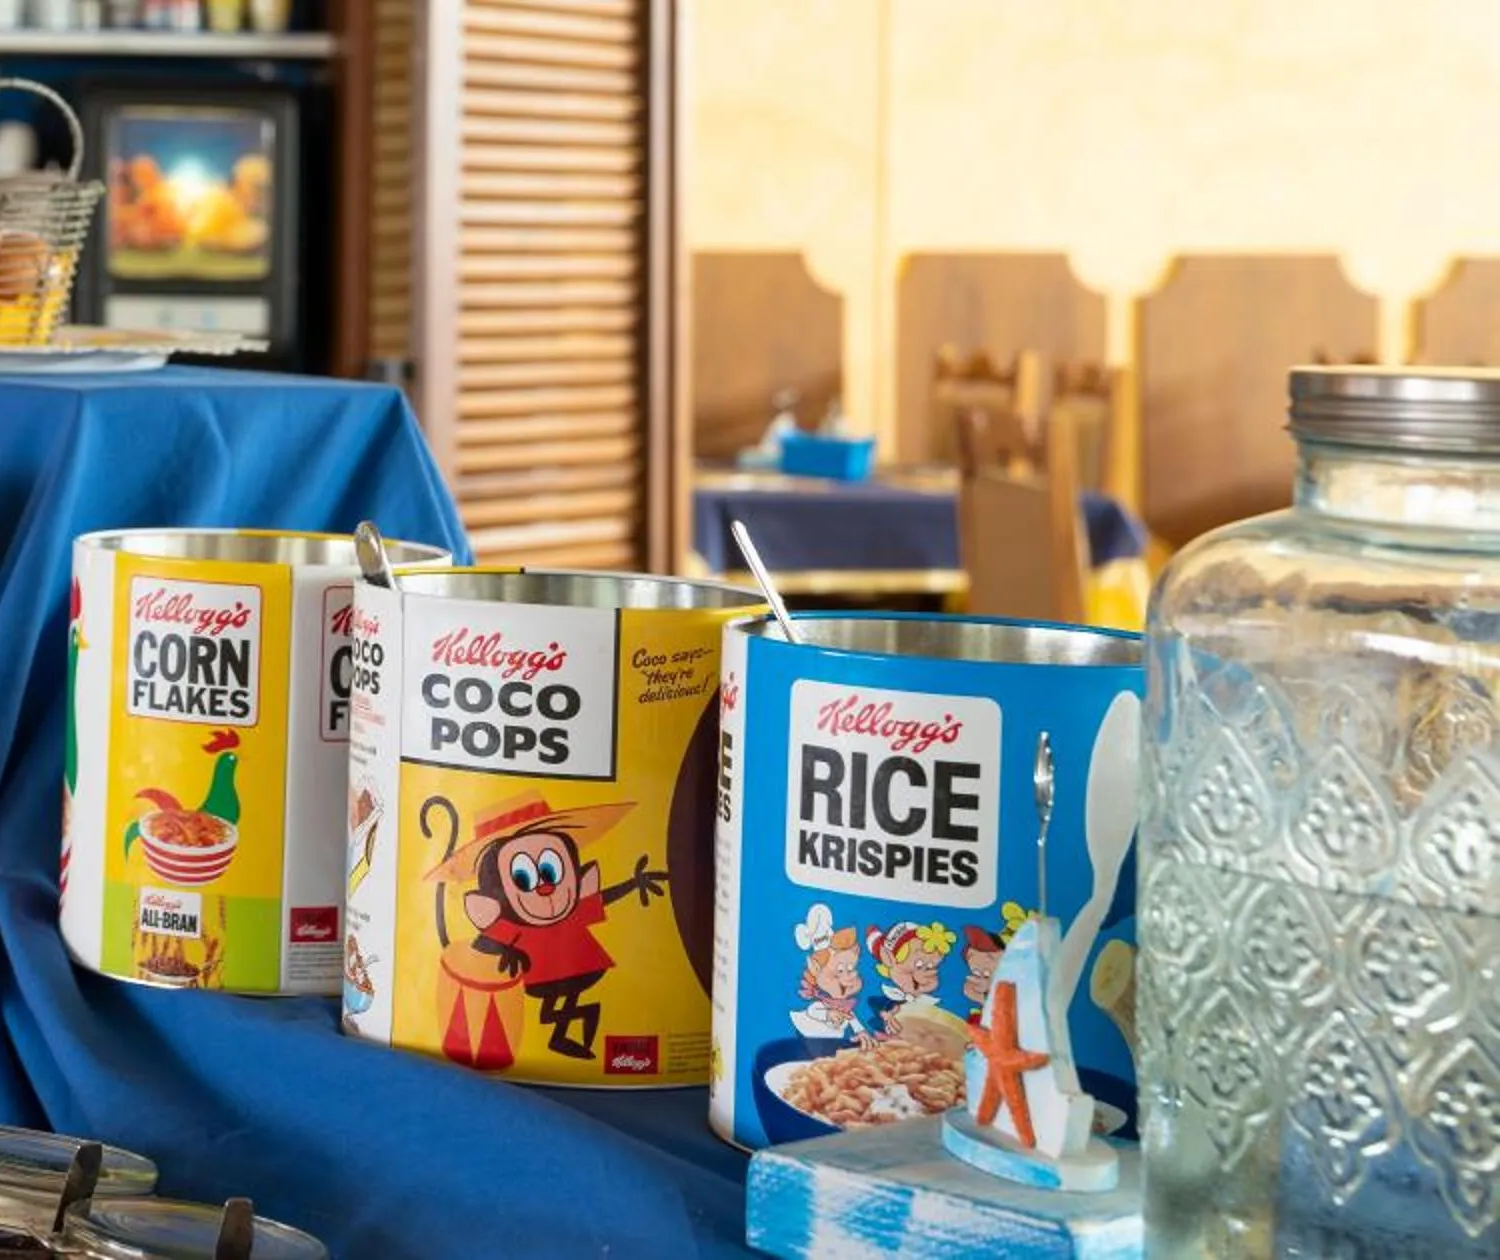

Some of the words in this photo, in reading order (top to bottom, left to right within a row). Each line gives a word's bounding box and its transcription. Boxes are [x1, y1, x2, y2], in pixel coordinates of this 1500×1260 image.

[135, 590, 251, 635] Kellogg's
[133, 631, 250, 688] CORN
[432, 628, 567, 680] Kellogg's
[632, 648, 667, 668] Coco
[133, 681, 250, 719] FLAKES
[421, 674, 581, 720] COCO
[431, 718, 570, 765] POPS
[818, 695, 964, 753] Kellogg's
[800, 744, 981, 842] RICE
[798, 830, 979, 887] KRISPIES
[141, 907, 198, 932] ALL-BRAN
